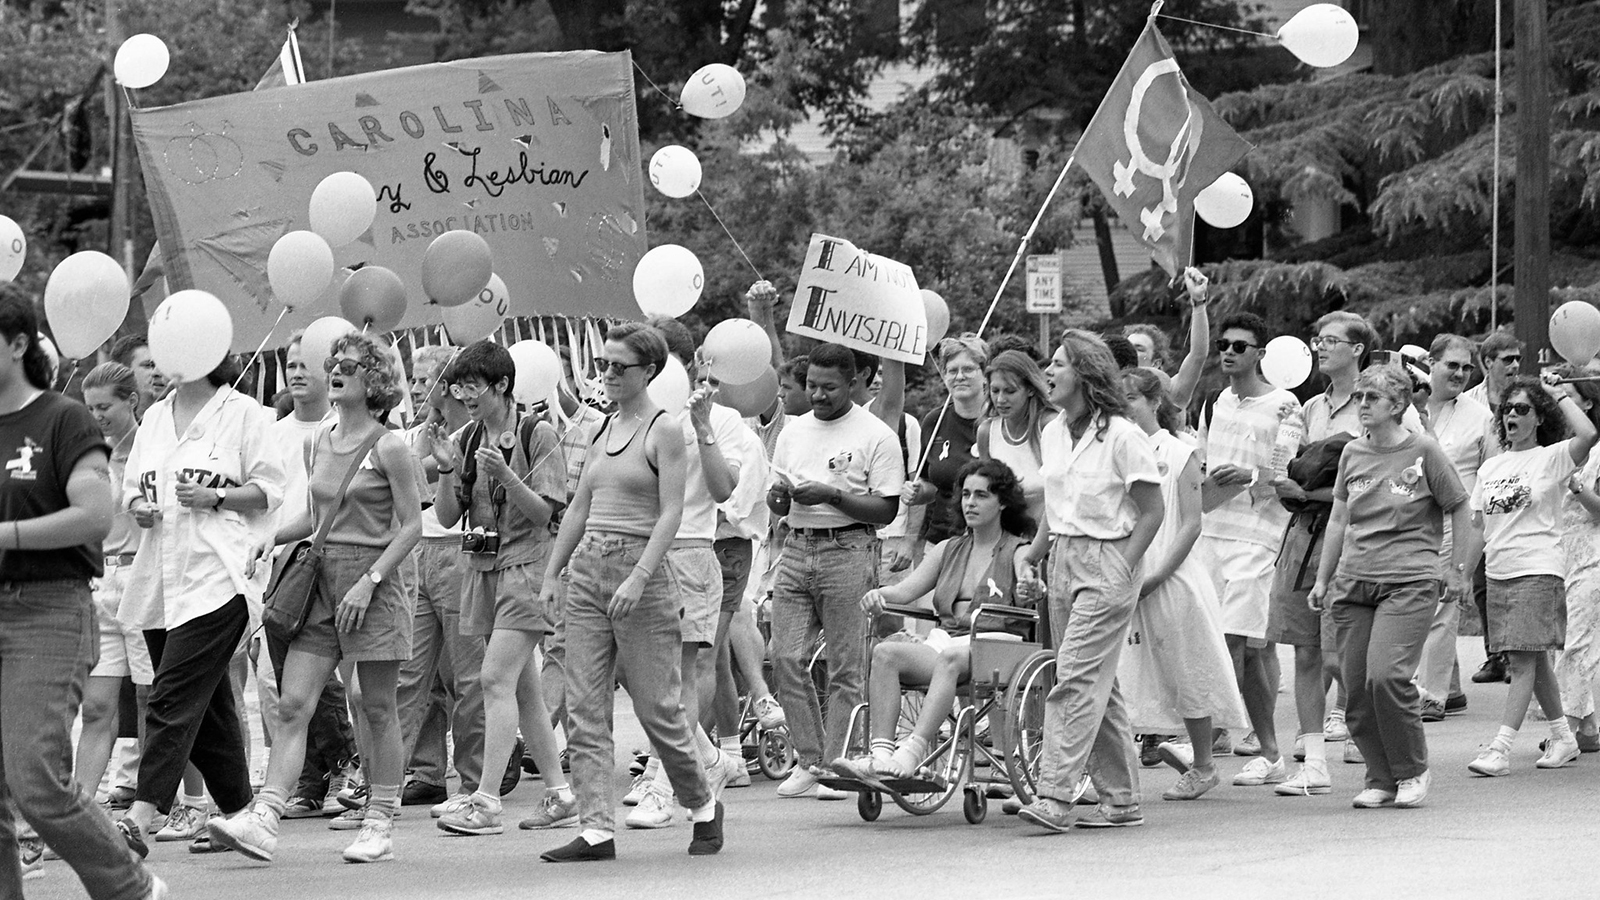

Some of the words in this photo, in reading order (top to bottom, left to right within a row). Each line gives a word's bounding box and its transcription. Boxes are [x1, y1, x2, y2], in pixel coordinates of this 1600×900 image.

[696, 68, 728, 108] UT!
[286, 95, 572, 157] CAROLINA
[423, 152, 451, 194] &
[459, 147, 590, 197] Lesbian
[391, 212, 535, 245] ASSOCIATION
[812, 239, 844, 272] I
[844, 255, 878, 282] AM
[1034, 288, 1055, 299] TIME
[1035, 276, 1054, 286] ANY
[798, 285, 926, 356] INVISIBLE
[1537, 348, 1550, 364] 11
